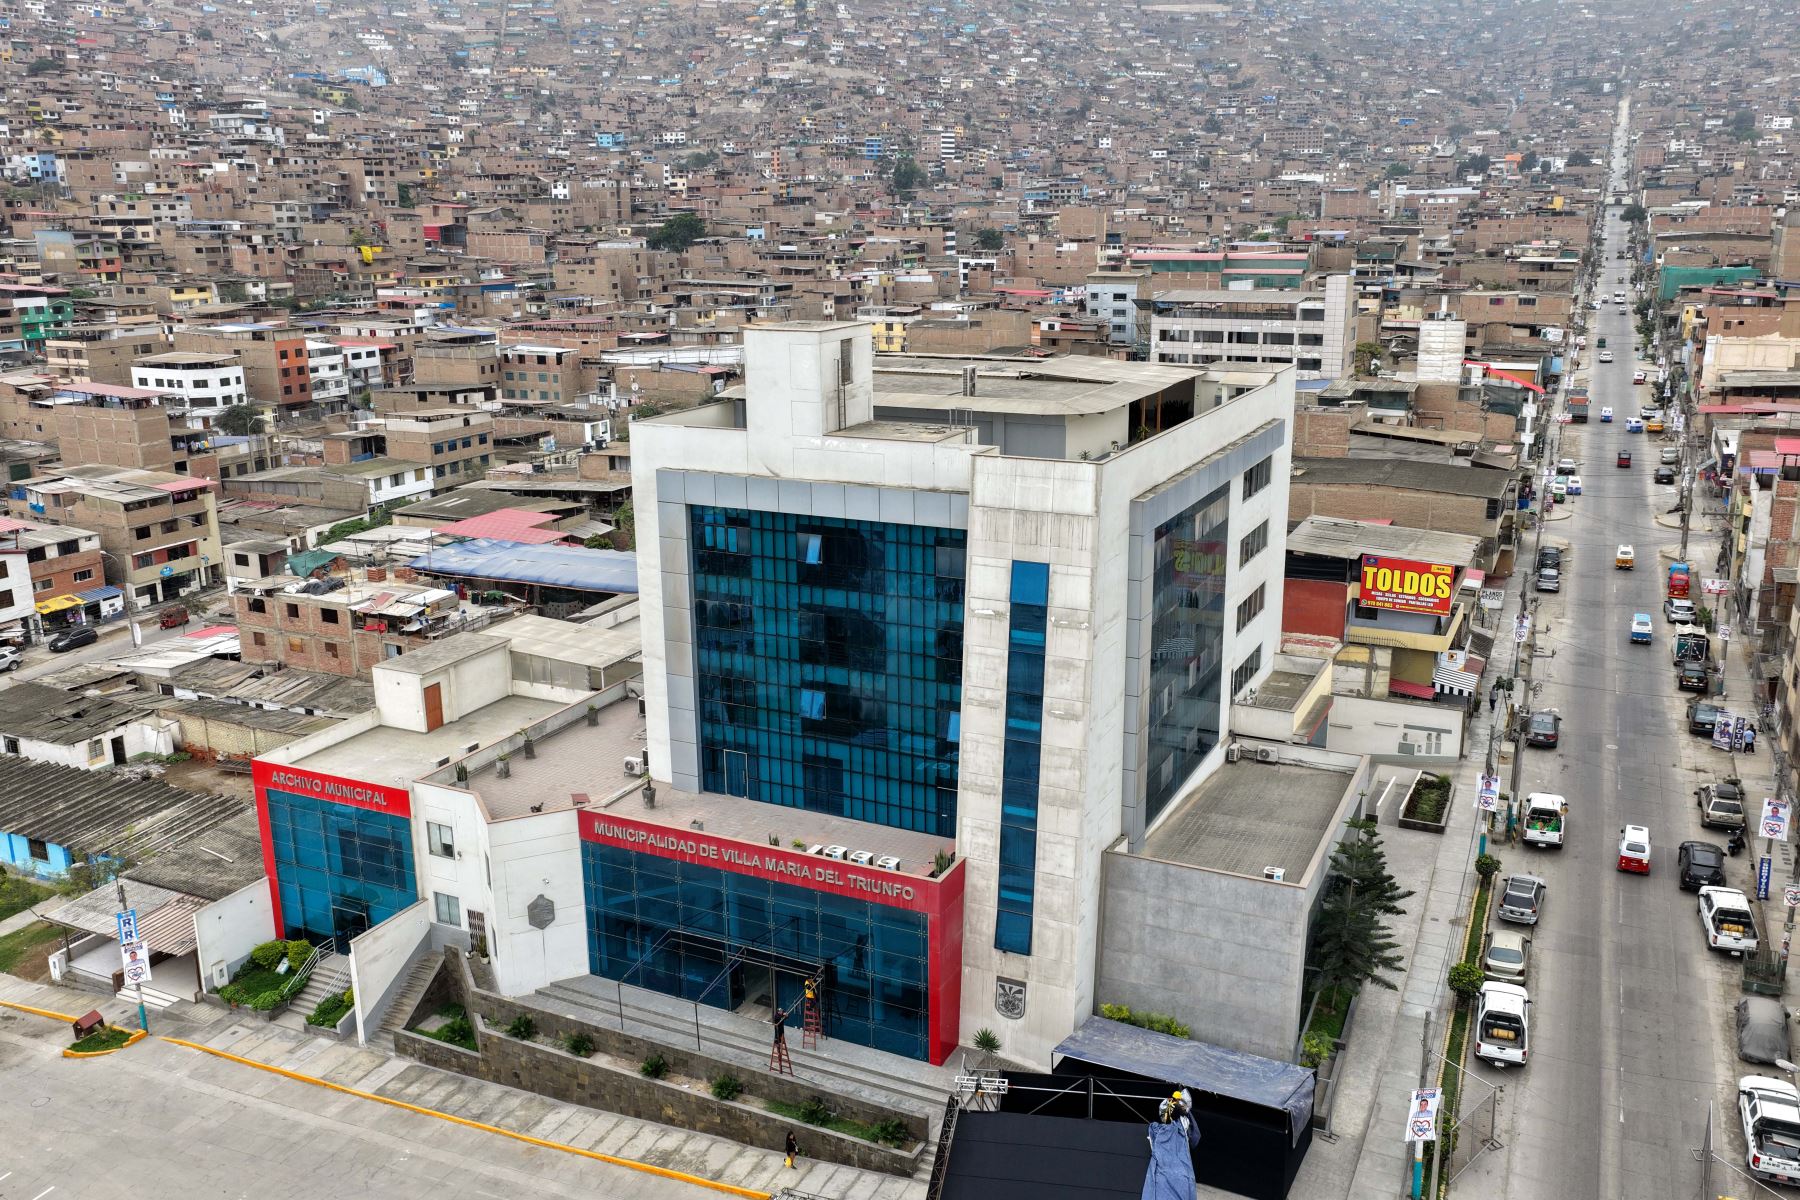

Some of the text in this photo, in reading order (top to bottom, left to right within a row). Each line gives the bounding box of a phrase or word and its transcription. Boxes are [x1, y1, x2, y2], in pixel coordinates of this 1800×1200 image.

[1364, 566, 1451, 599] TOLDOS
[272, 770, 387, 806] ARCHIVO MUNICIPAL
[594, 822, 697, 855] MUNICIPALIDAD
[699, 843, 719, 860] DE
[721, 848, 762, 869] VILLA
[815, 867, 844, 886] DEL
[847, 874, 914, 901] TRIUNFO
[122, 918, 132, 927] R
[124, 930, 134, 940] R
